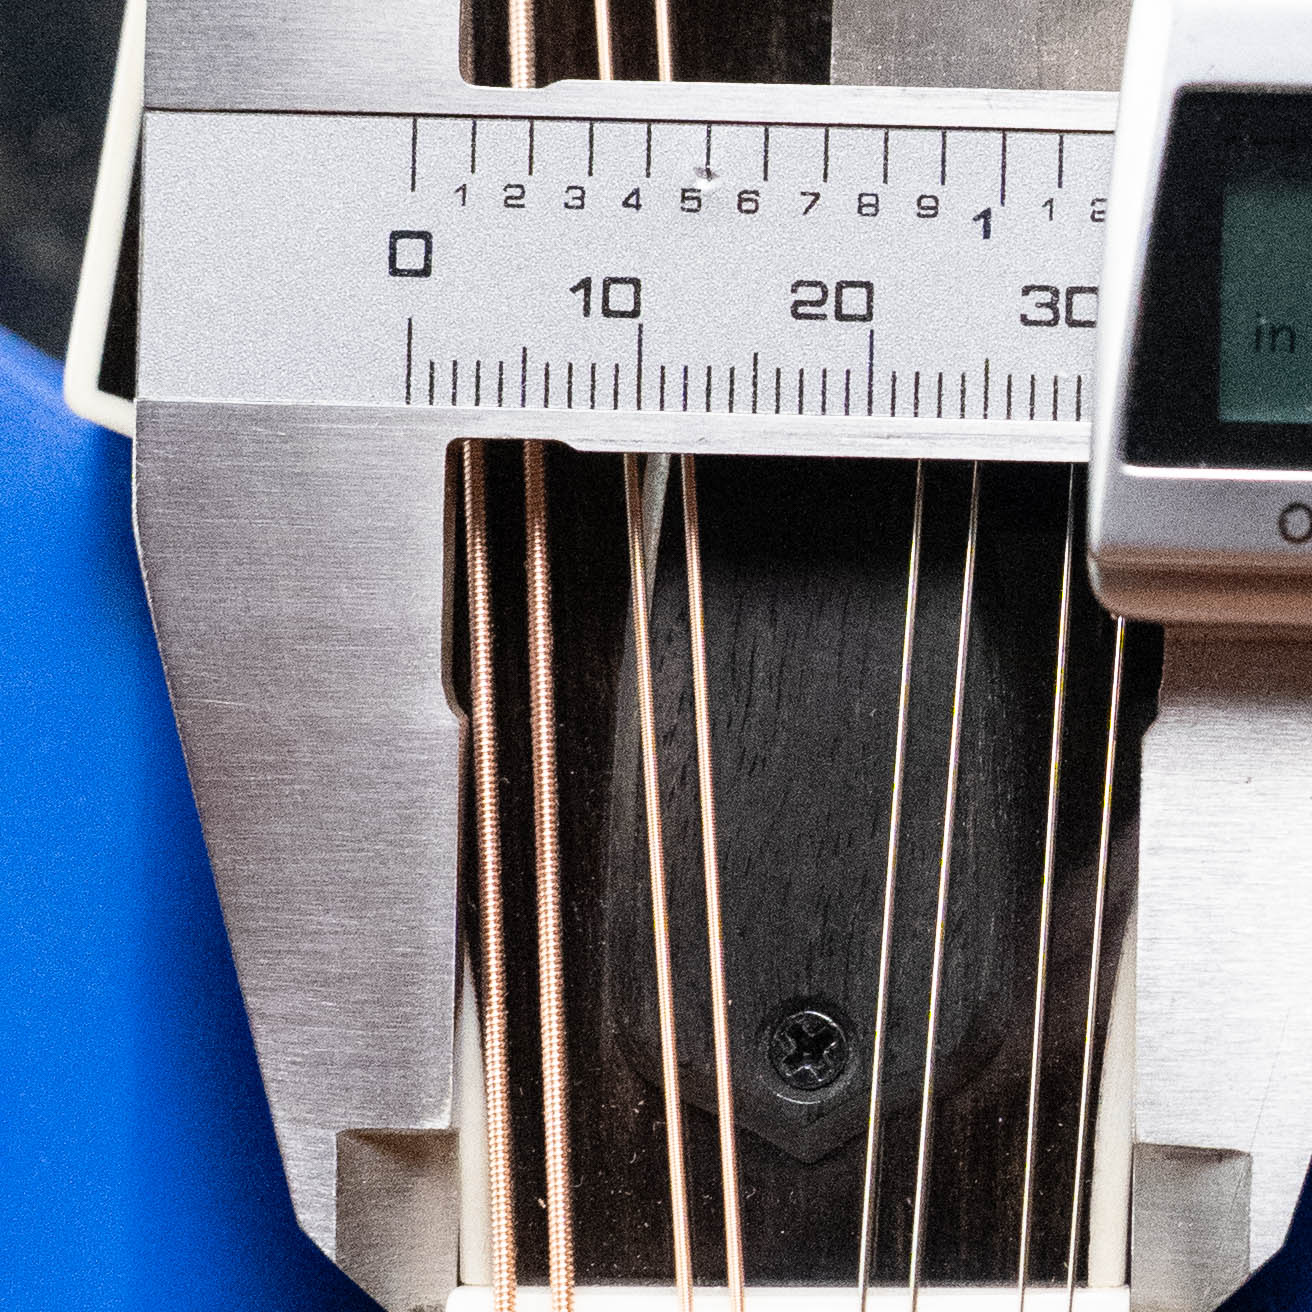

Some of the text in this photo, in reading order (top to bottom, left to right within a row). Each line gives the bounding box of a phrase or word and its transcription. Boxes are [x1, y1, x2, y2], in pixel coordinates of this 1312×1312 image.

[454, 184, 468, 207] 1
[503, 183, 526, 209] 2
[563, 185, 586, 210] 3
[621, 187, 643, 212] 4
[680, 187, 703, 214] 5
[736, 189, 760, 215] 6
[800, 191, 822, 216] 7
[856, 192, 880, 218] 8
[916, 194, 940, 219] 9
[972, 207, 992, 240] 1
[1041, 197, 1054, 222] 1
[387, 229, 433, 279] 0
[568, 276, 1099, 329] 10 20 30
[1254, 312, 1297, 354] in
